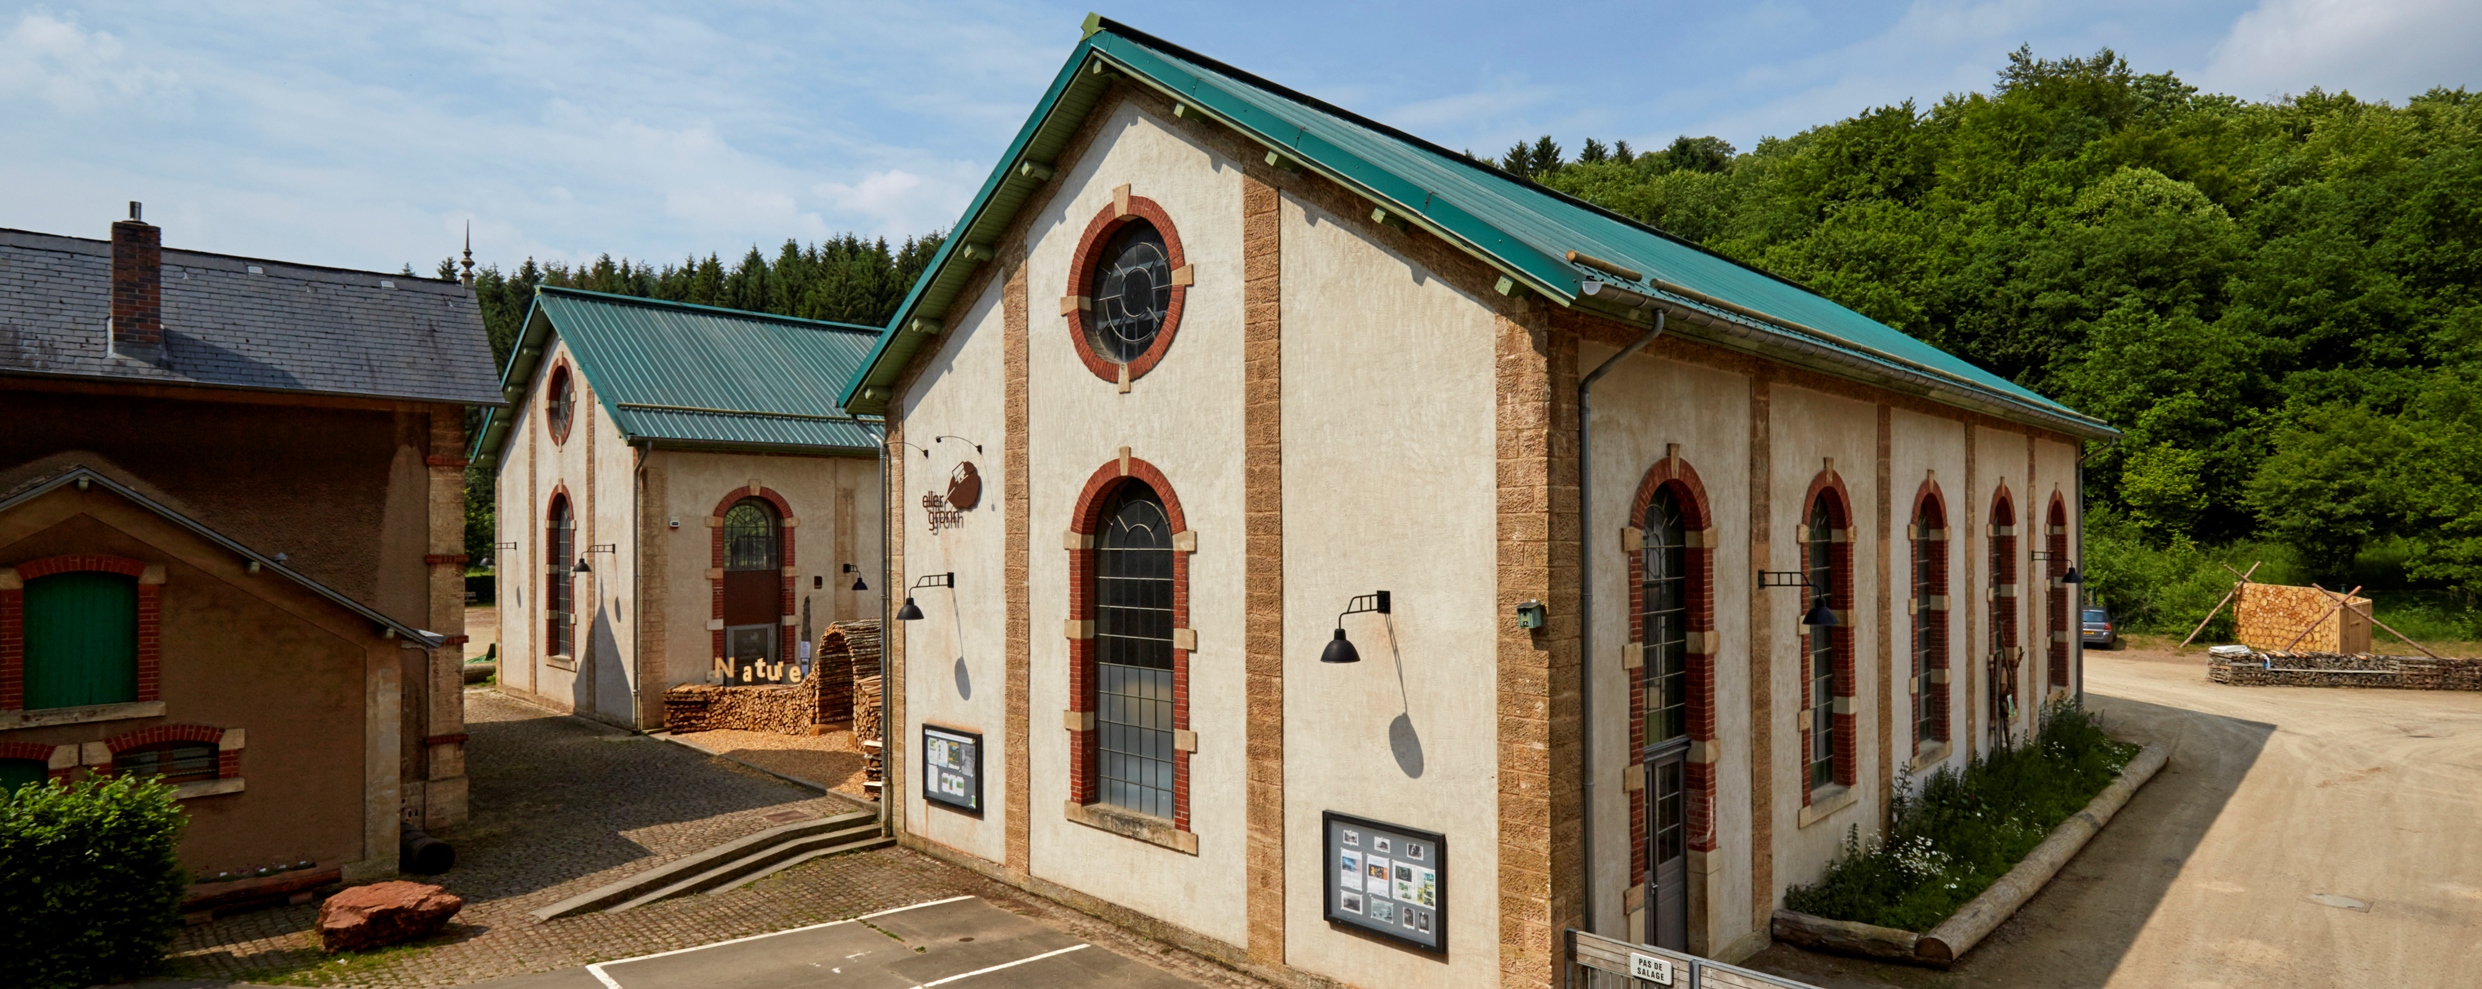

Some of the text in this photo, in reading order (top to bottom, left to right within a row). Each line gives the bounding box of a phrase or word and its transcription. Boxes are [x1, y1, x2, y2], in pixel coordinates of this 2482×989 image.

[922, 490, 944, 508] eller
[714, 656, 801, 683] Nature
[1638, 958, 1663, 971] PAS DE
[1637, 967, 1665, 981] SALAGE
